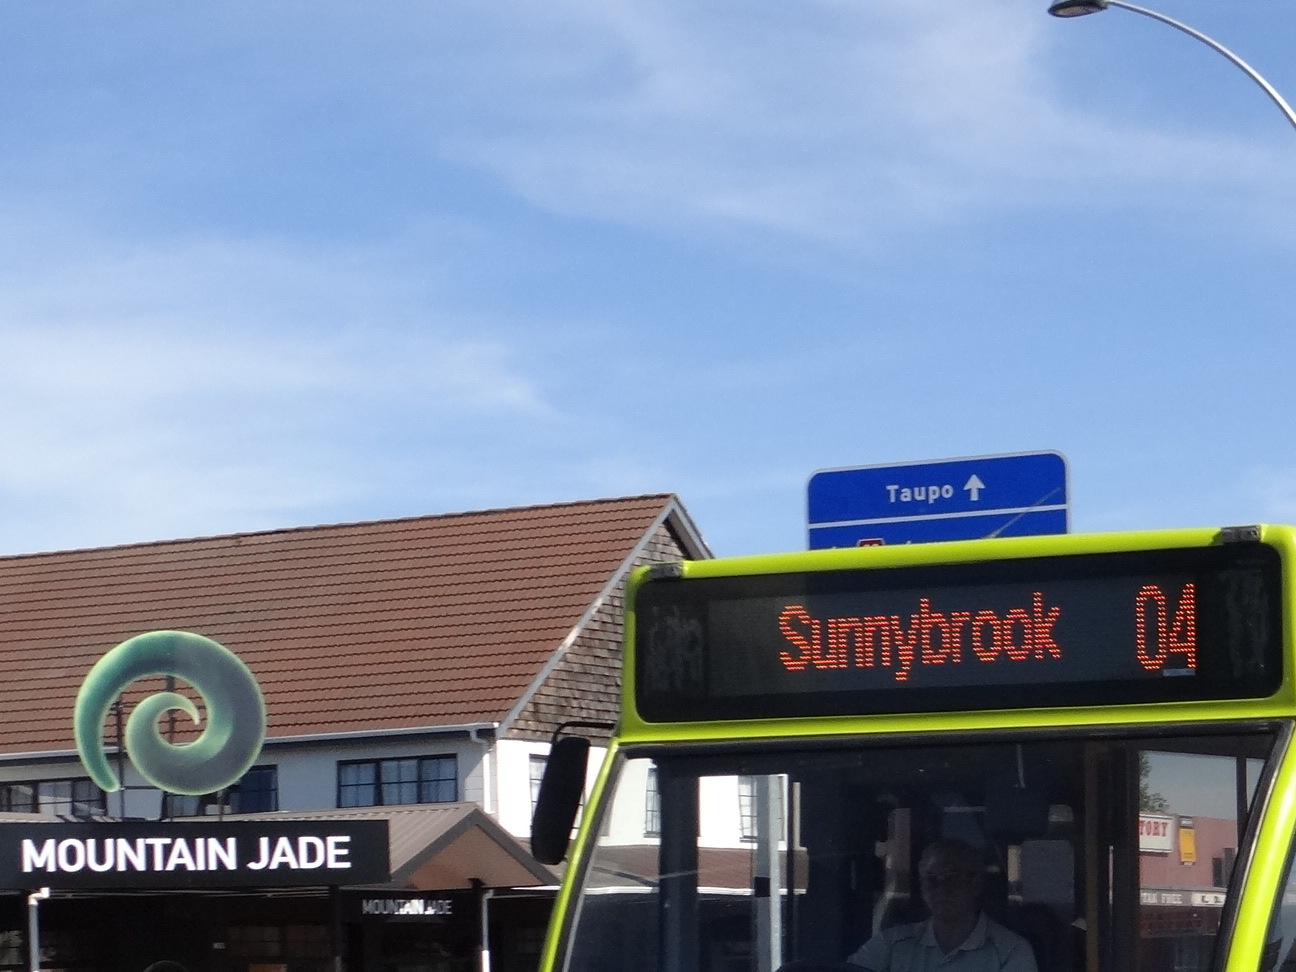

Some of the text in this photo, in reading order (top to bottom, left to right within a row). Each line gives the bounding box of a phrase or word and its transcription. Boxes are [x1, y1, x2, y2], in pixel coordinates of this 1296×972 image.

[885, 484, 954, 504] Taupo
[777, 583, 1196, 681] Sunnybrook 04
[21, 836, 352, 872] MOUNTAIN JADE
[362, 899, 424, 915] MOUNTAIN
